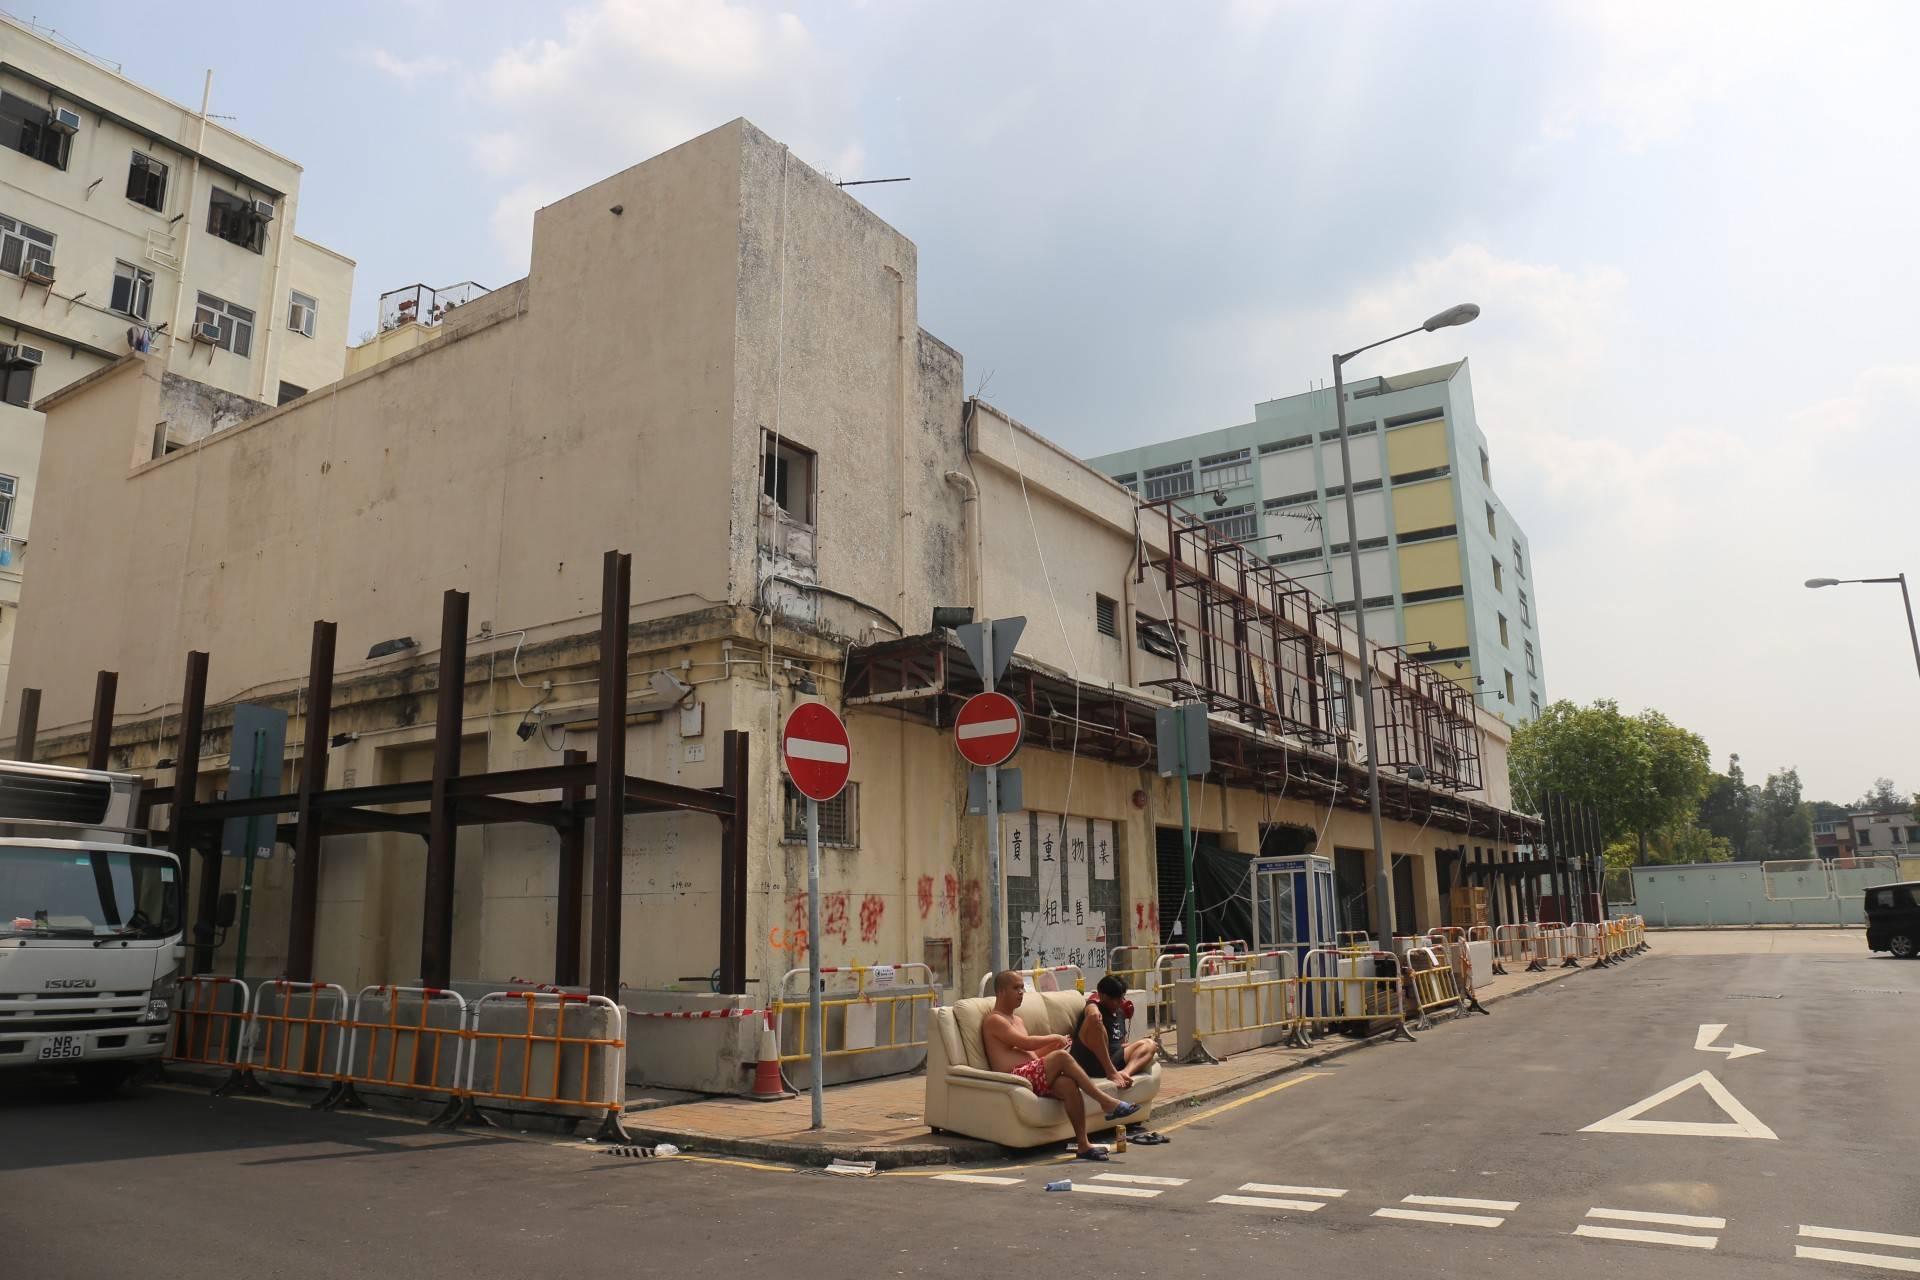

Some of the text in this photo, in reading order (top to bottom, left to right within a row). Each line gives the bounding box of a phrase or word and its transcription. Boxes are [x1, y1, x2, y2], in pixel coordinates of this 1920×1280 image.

[45, 979, 97, 989] ISUZU
[53, 1036, 73, 1047] NR
[42, 1045, 81, 1058] 9550
